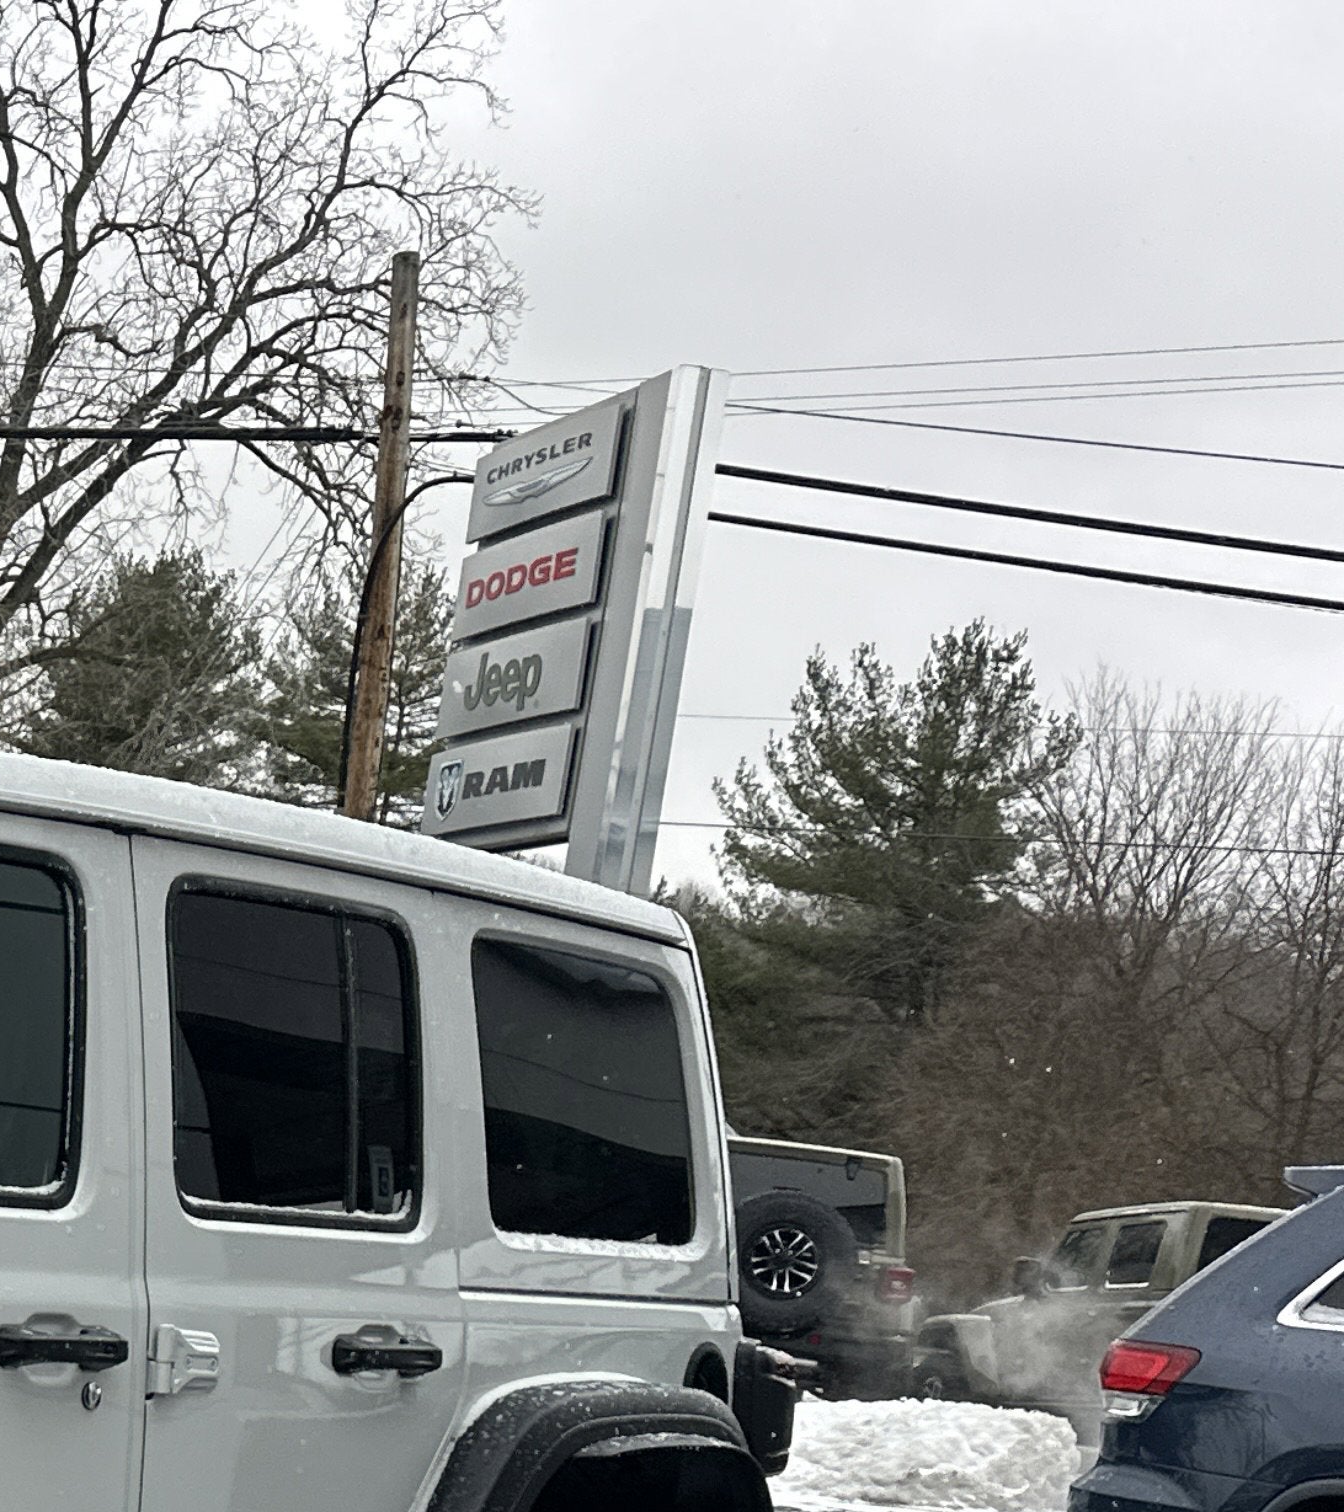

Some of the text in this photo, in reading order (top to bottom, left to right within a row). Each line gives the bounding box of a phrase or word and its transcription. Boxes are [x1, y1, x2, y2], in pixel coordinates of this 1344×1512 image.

[486, 430, 593, 486] CHRYSLER
[464, 547, 580, 610] DODGE
[463, 652, 543, 712] Jeep
[462, 757, 547, 800] RAM
